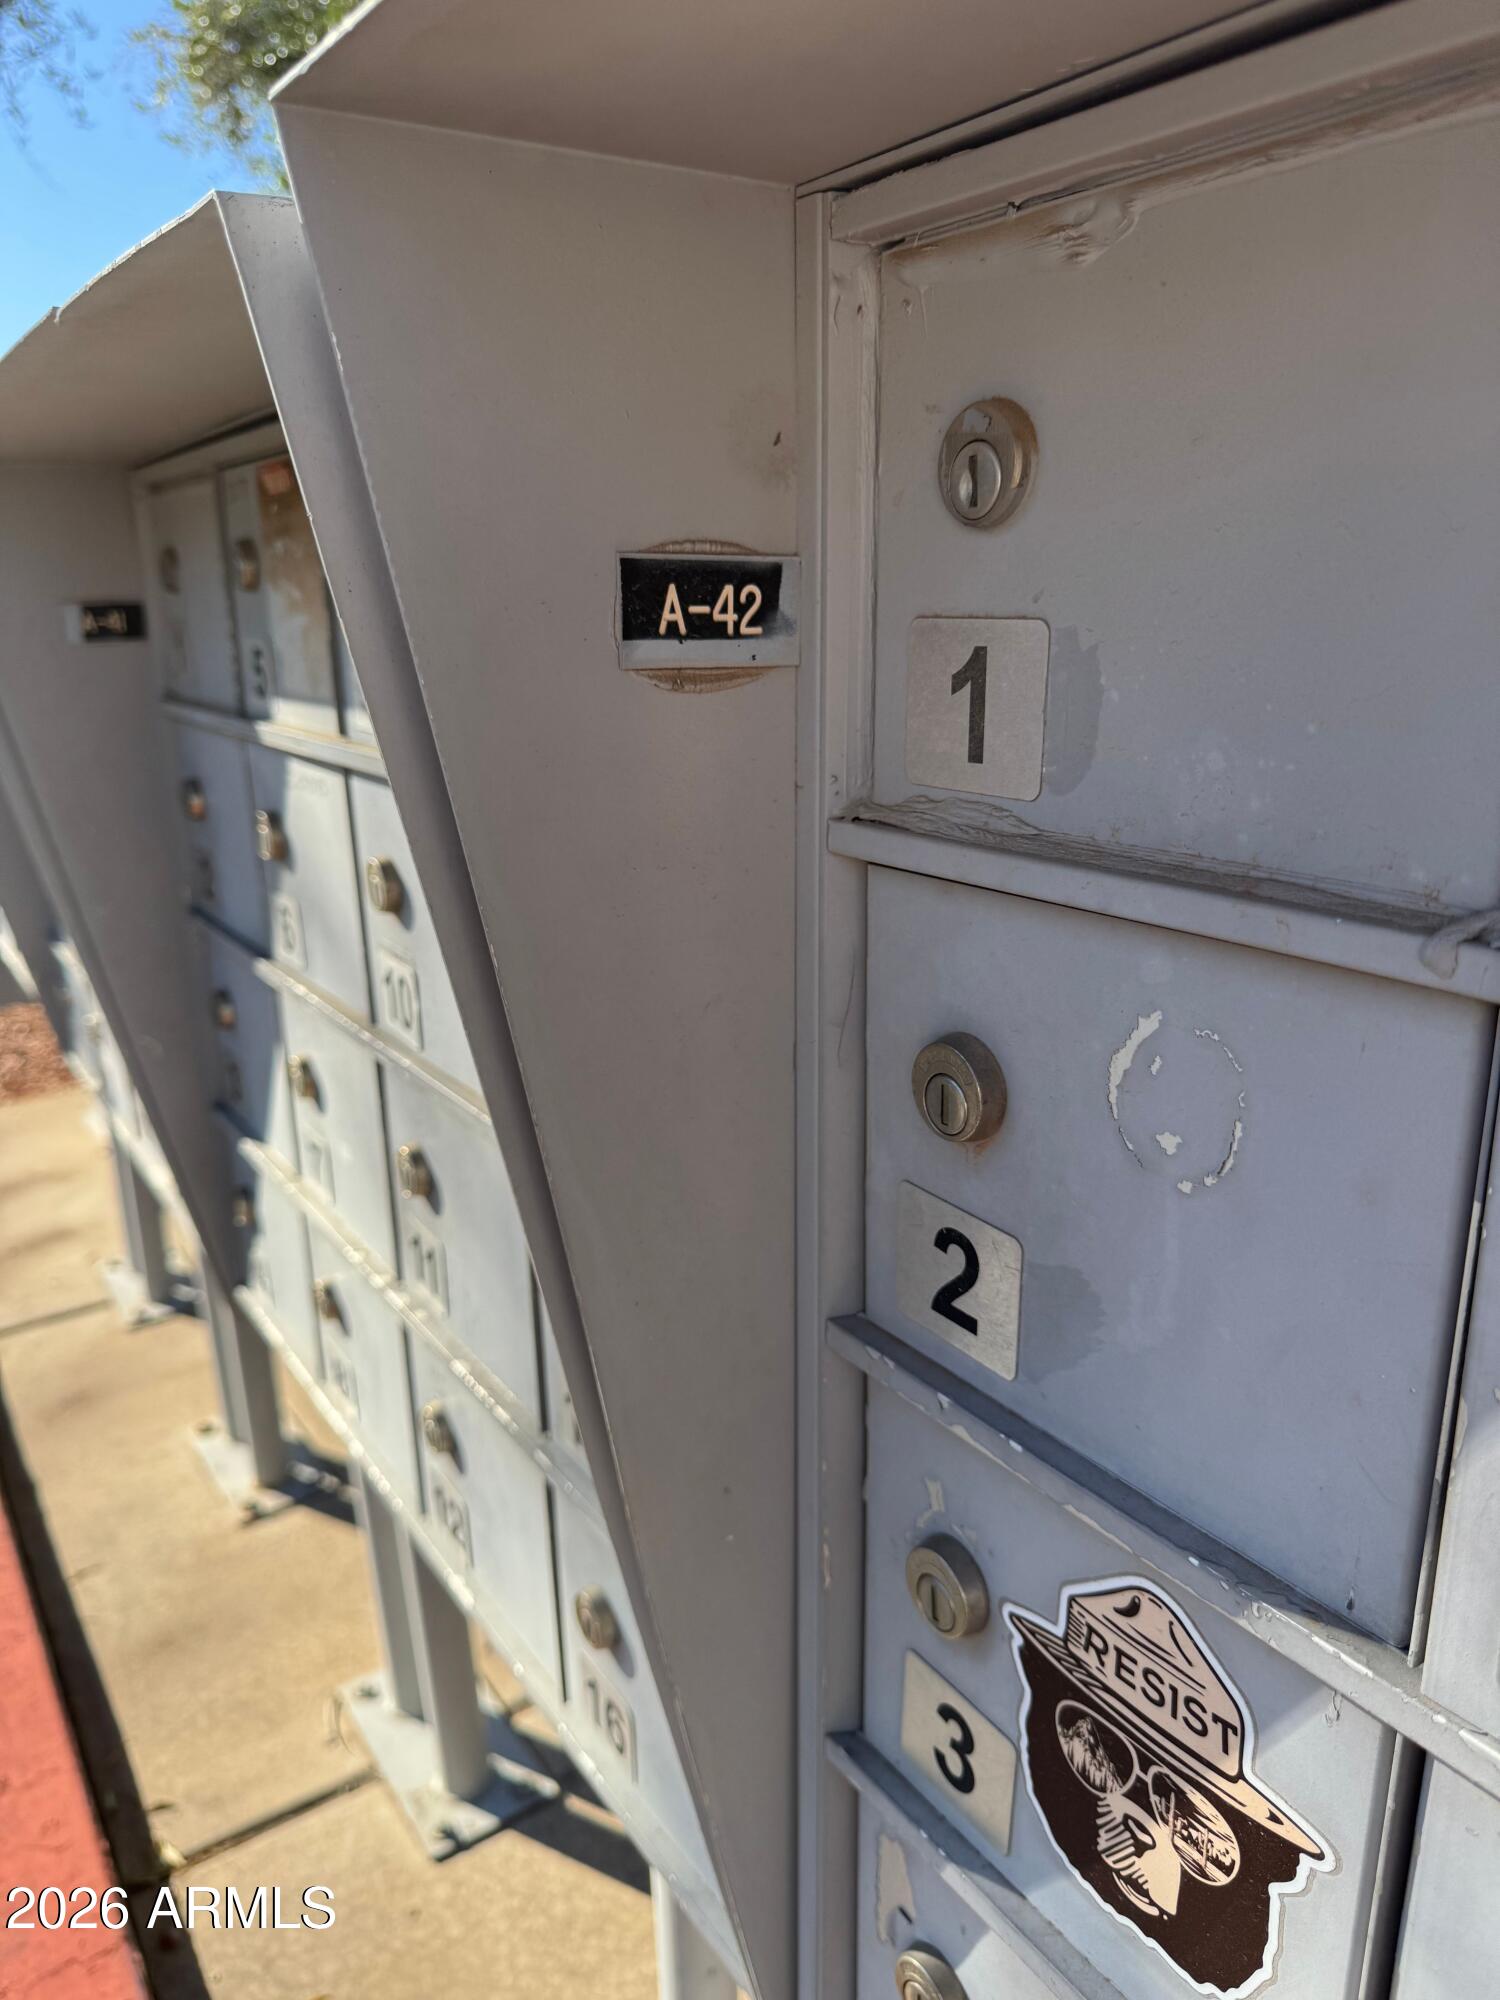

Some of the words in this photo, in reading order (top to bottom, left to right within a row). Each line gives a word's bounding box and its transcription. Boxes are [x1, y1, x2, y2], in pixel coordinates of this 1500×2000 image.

[659, 583, 763, 636] A-42
[951, 646, 988, 765] 1
[384, 967, 413, 1030] 10
[407, 1234, 439, 1295] 11
[931, 1226, 980, 1337] 2
[587, 1679, 625, 1756] 16
[1082, 1622, 1240, 1758] RESIST
[933, 1702, 976, 1795] 3
